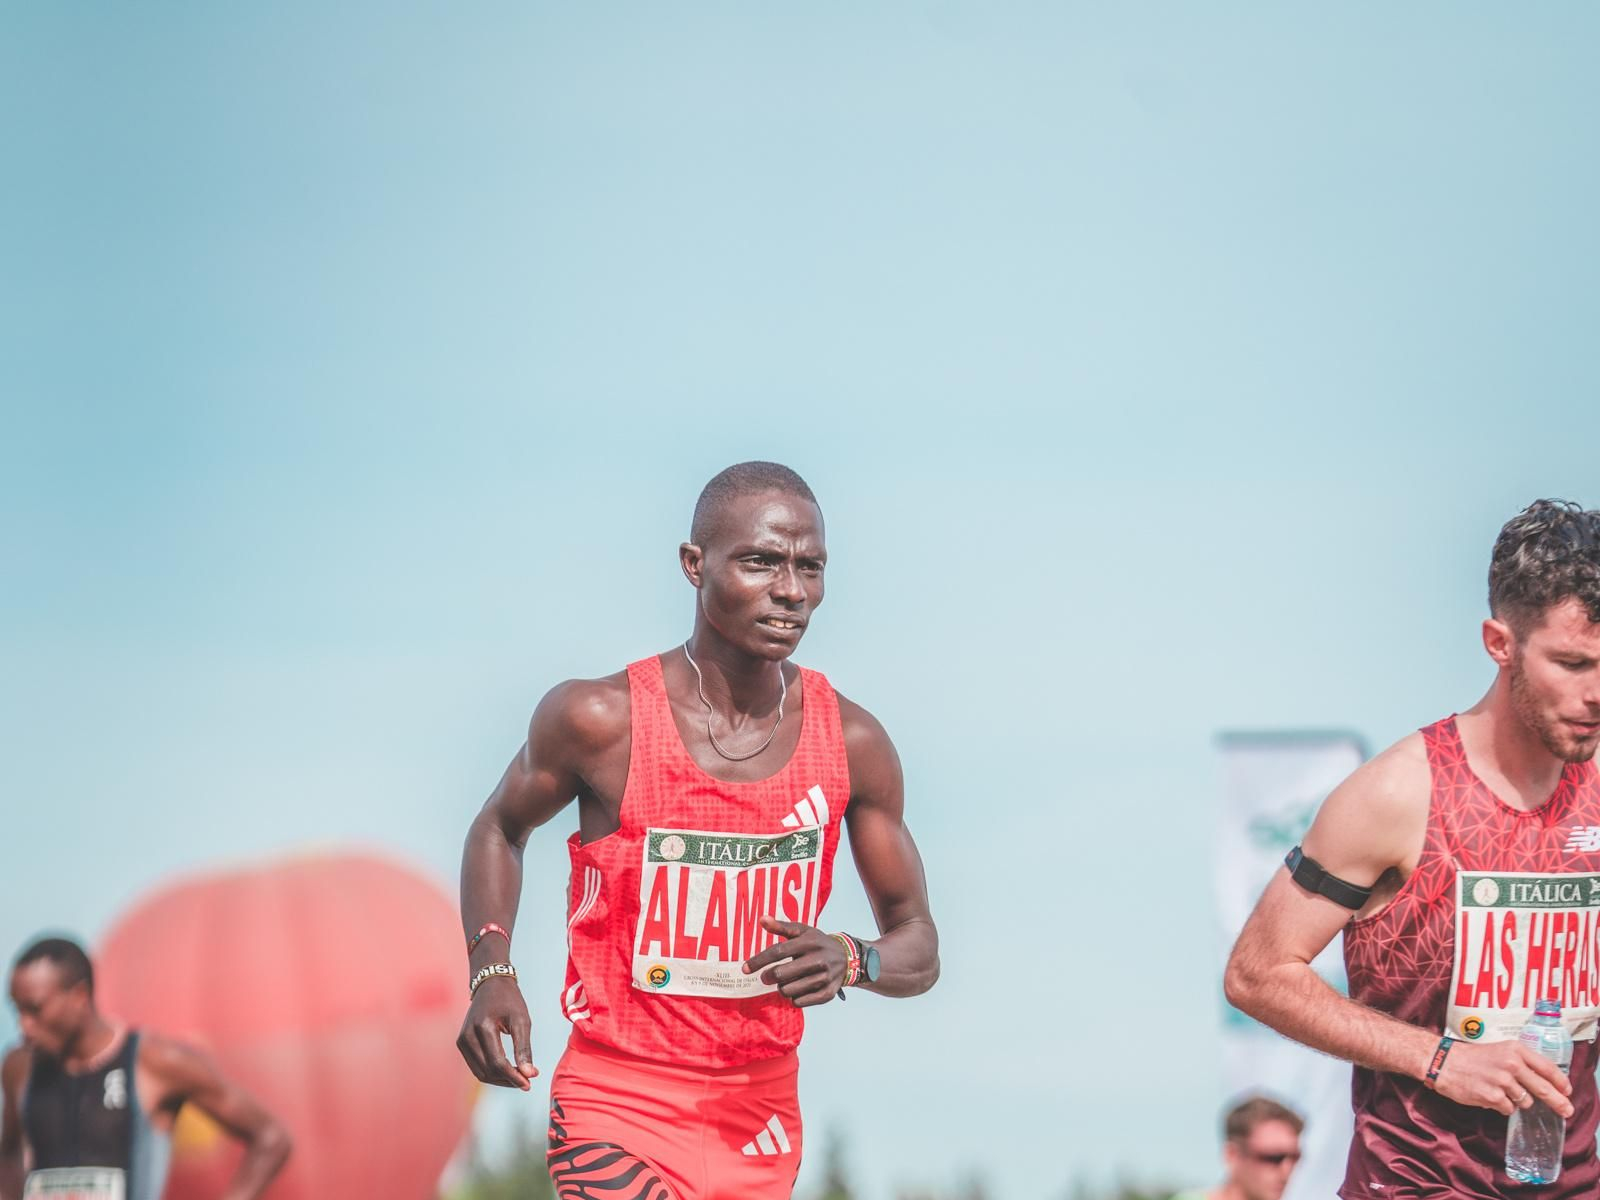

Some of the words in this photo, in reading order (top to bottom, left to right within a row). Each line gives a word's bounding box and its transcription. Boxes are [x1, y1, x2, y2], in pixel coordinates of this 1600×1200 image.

[699, 839, 779, 862] ITÁLICA
[639, 861, 816, 962] ALAMISI
[1510, 879, 1582, 902] ITÁLICA
[1455, 911, 1517, 1009] LAS
[1522, 911, 1600, 1008] HERAS
